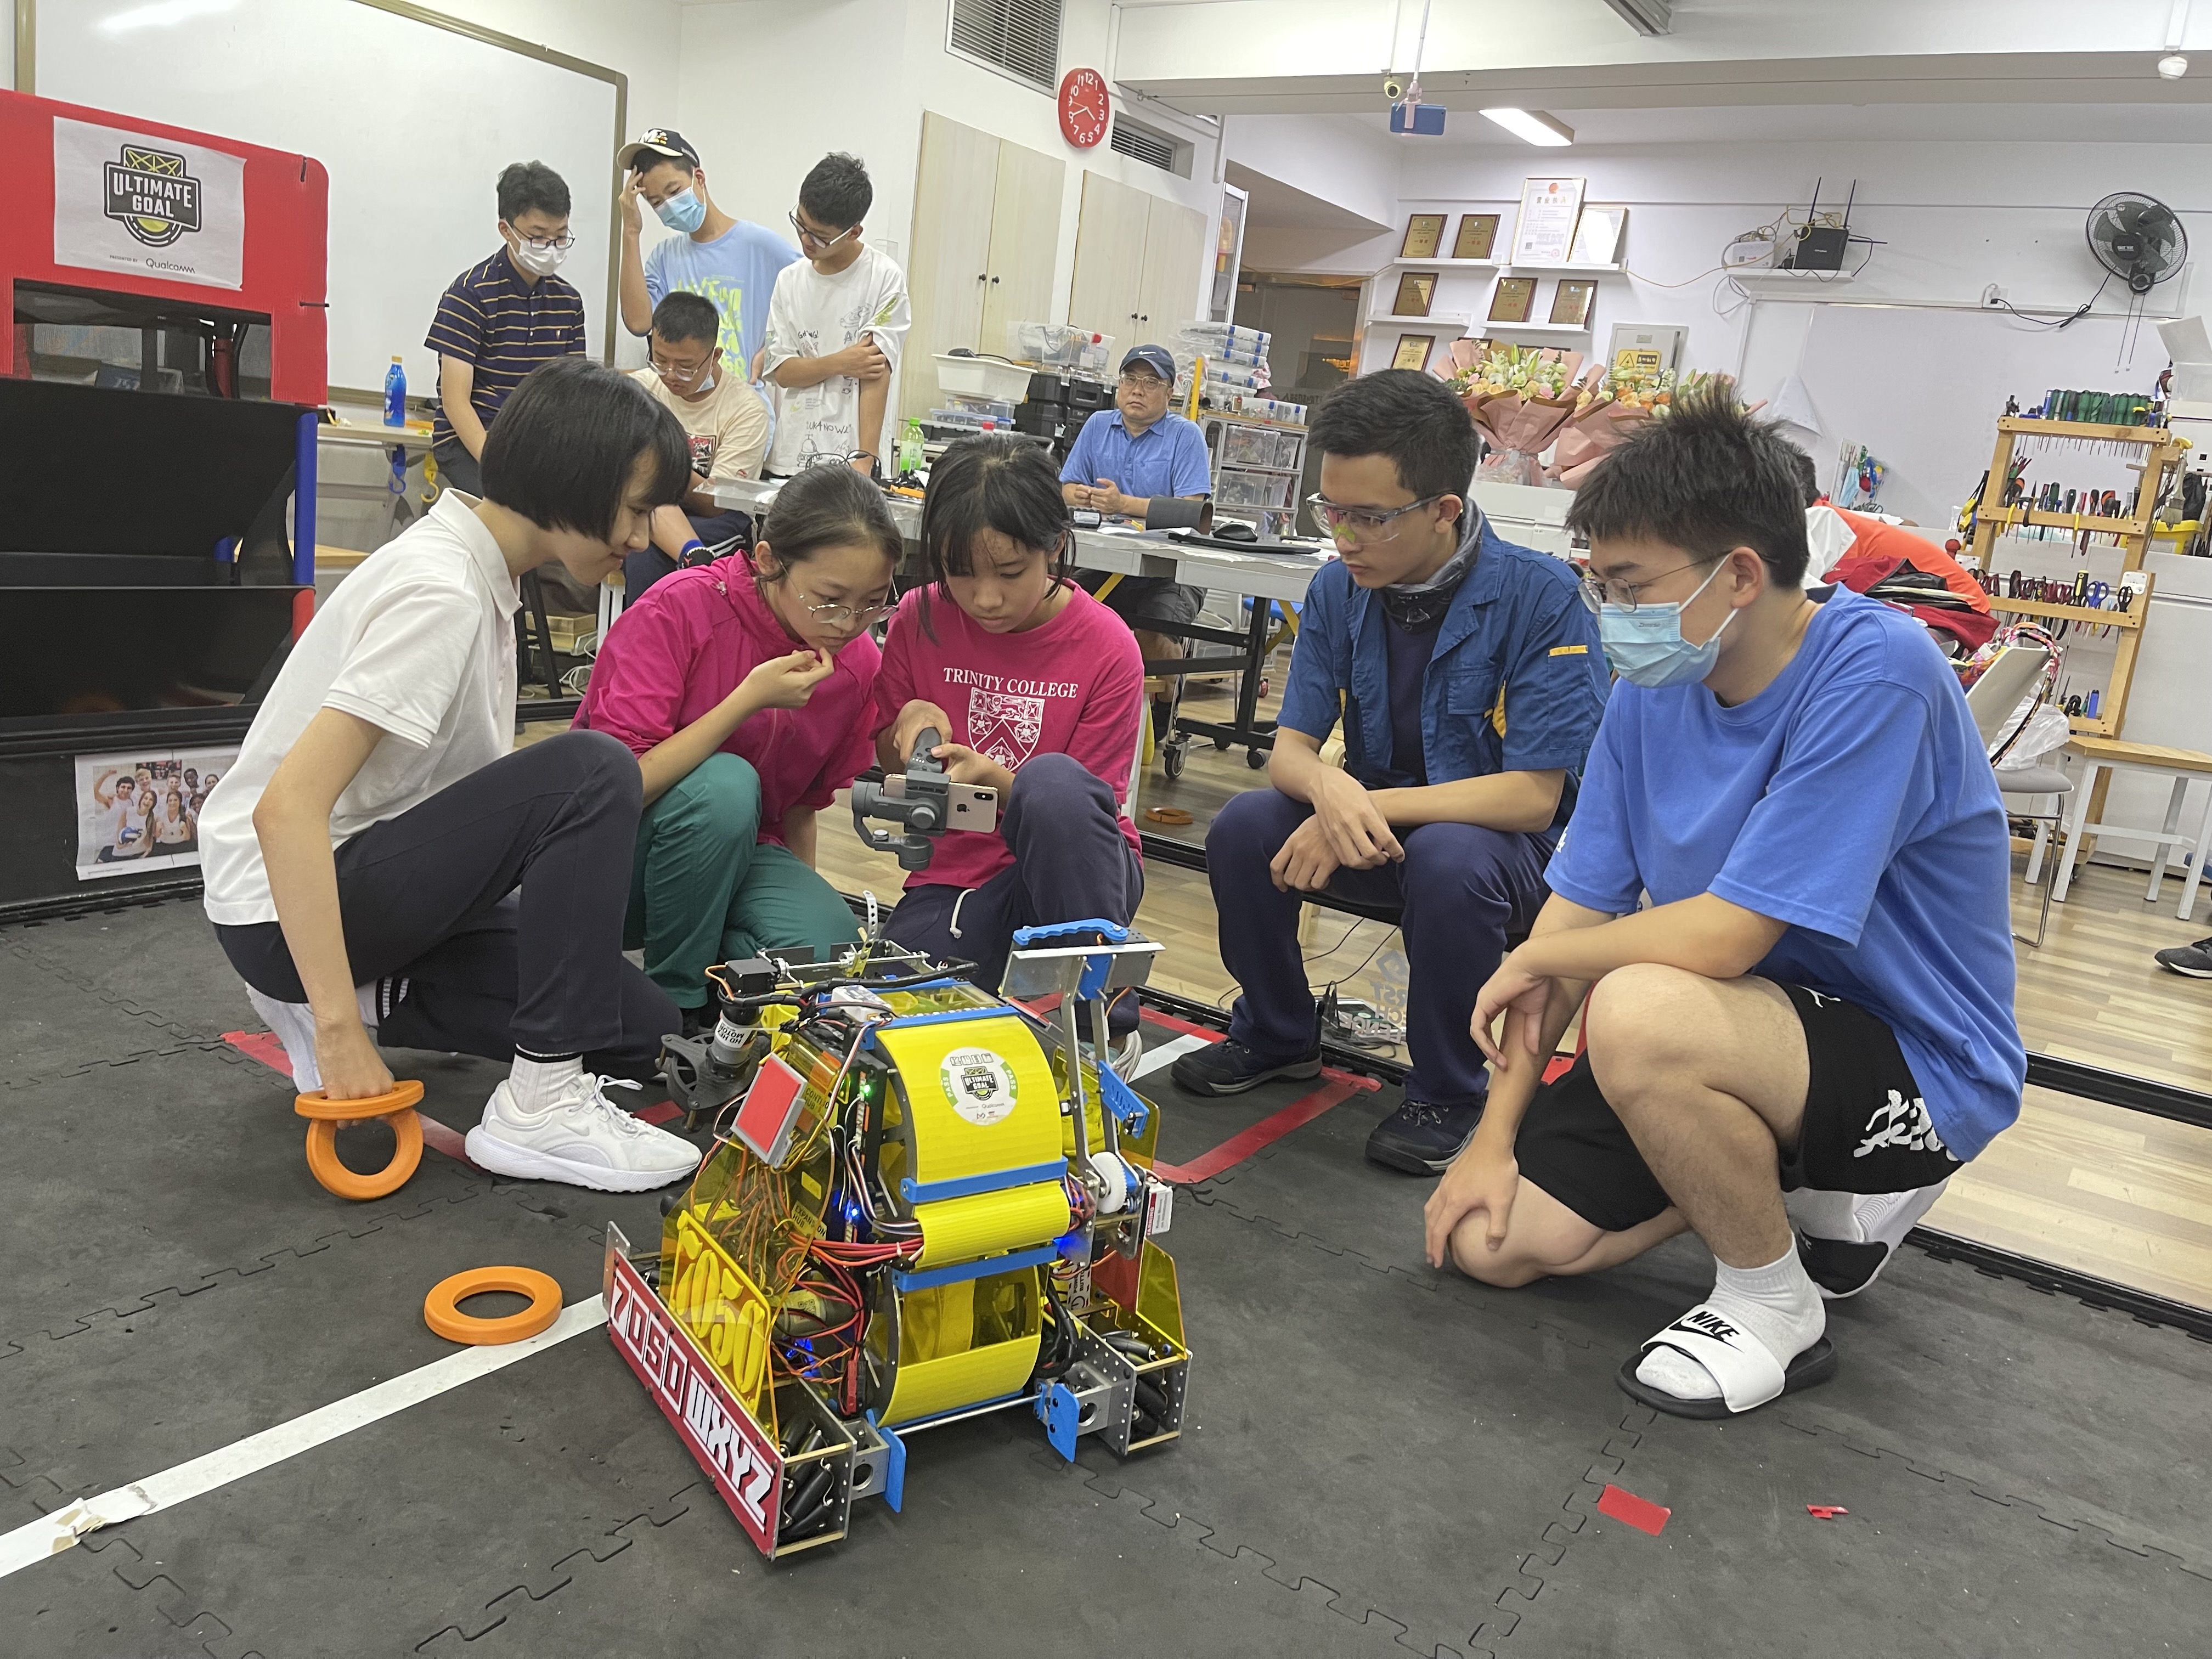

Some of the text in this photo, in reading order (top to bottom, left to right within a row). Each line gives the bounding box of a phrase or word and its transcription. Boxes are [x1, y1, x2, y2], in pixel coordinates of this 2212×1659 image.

[1077, 74, 1084, 86] 11
[1085, 72, 1093, 85] 12
[1071, 85, 1079, 97] 10
[1094, 80, 1098, 91] 1
[1098, 93, 1104, 105] 2
[1069, 111, 1074, 123] 8
[1098, 109, 1105, 121] 3
[1074, 125, 1079, 134] 7
[1094, 123, 1100, 134] 4
[1079, 132, 1086, 144] 6
[1087, 131, 1093, 142] 5
[113, 172, 193, 208] ULTIMATE
[132, 194, 174, 218] GOAL
[145, 258, 196, 274] Qualcomm
[943, 667, 1079, 698] TRINITY COLLEGE
[964, 1074, 994, 1086] ULTIMATE
[1006, 1069, 1017, 1090] PASS
[943, 1076, 953, 1098] PASS
[793, 1214, 805, 1228] HUB
[795, 1205, 827, 1237] EXPANSON
[1686, 1310, 1740, 1341] NIKE
[685, 1372, 772, 1526] WXYZ
